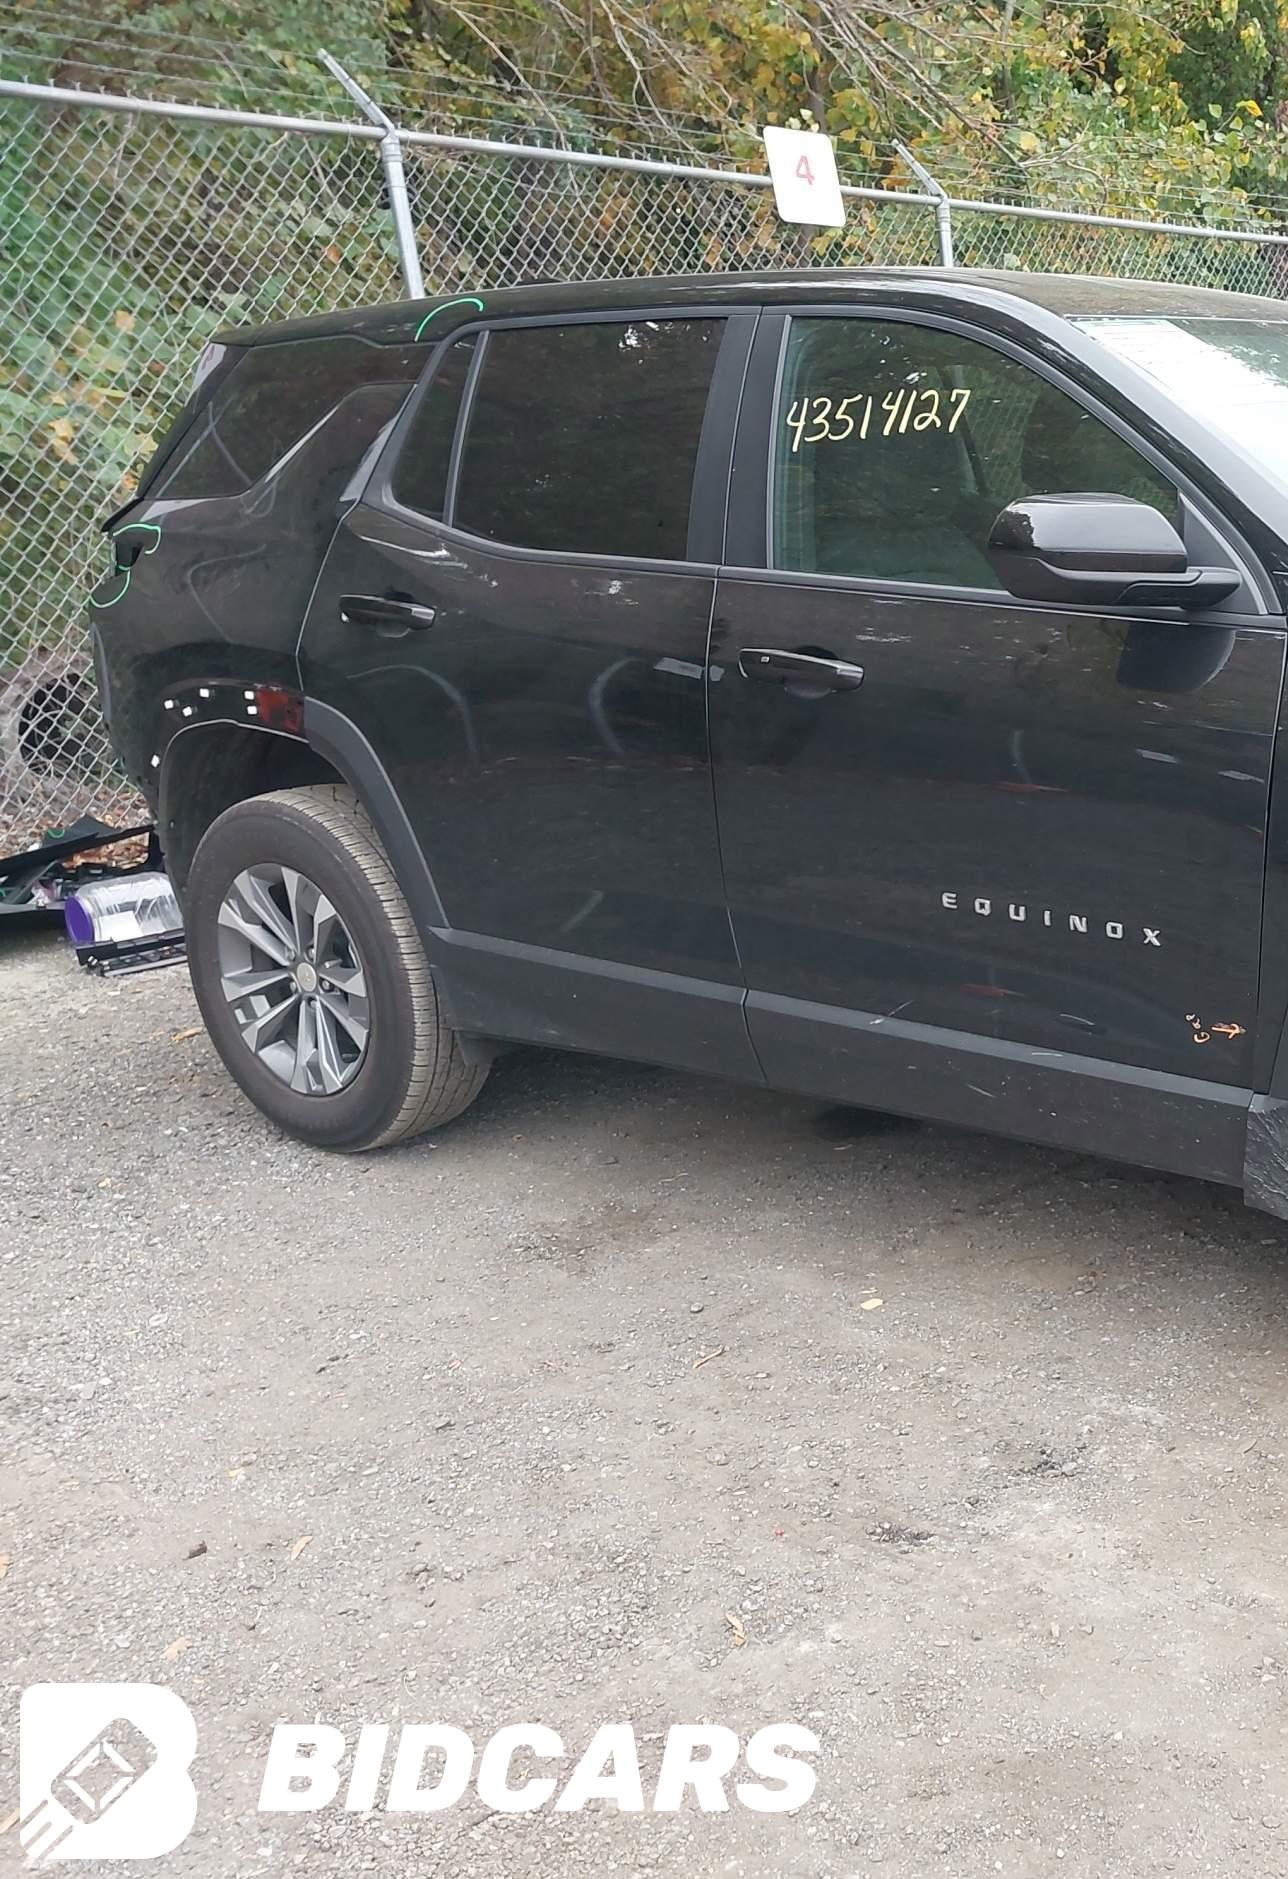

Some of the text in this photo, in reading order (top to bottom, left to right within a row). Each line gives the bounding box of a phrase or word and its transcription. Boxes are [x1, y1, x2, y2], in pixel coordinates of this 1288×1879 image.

[796, 155, 815, 185] 4
[786, 388, 972, 453] 43514127
[941, 891, 1162, 947] EQUINOX
